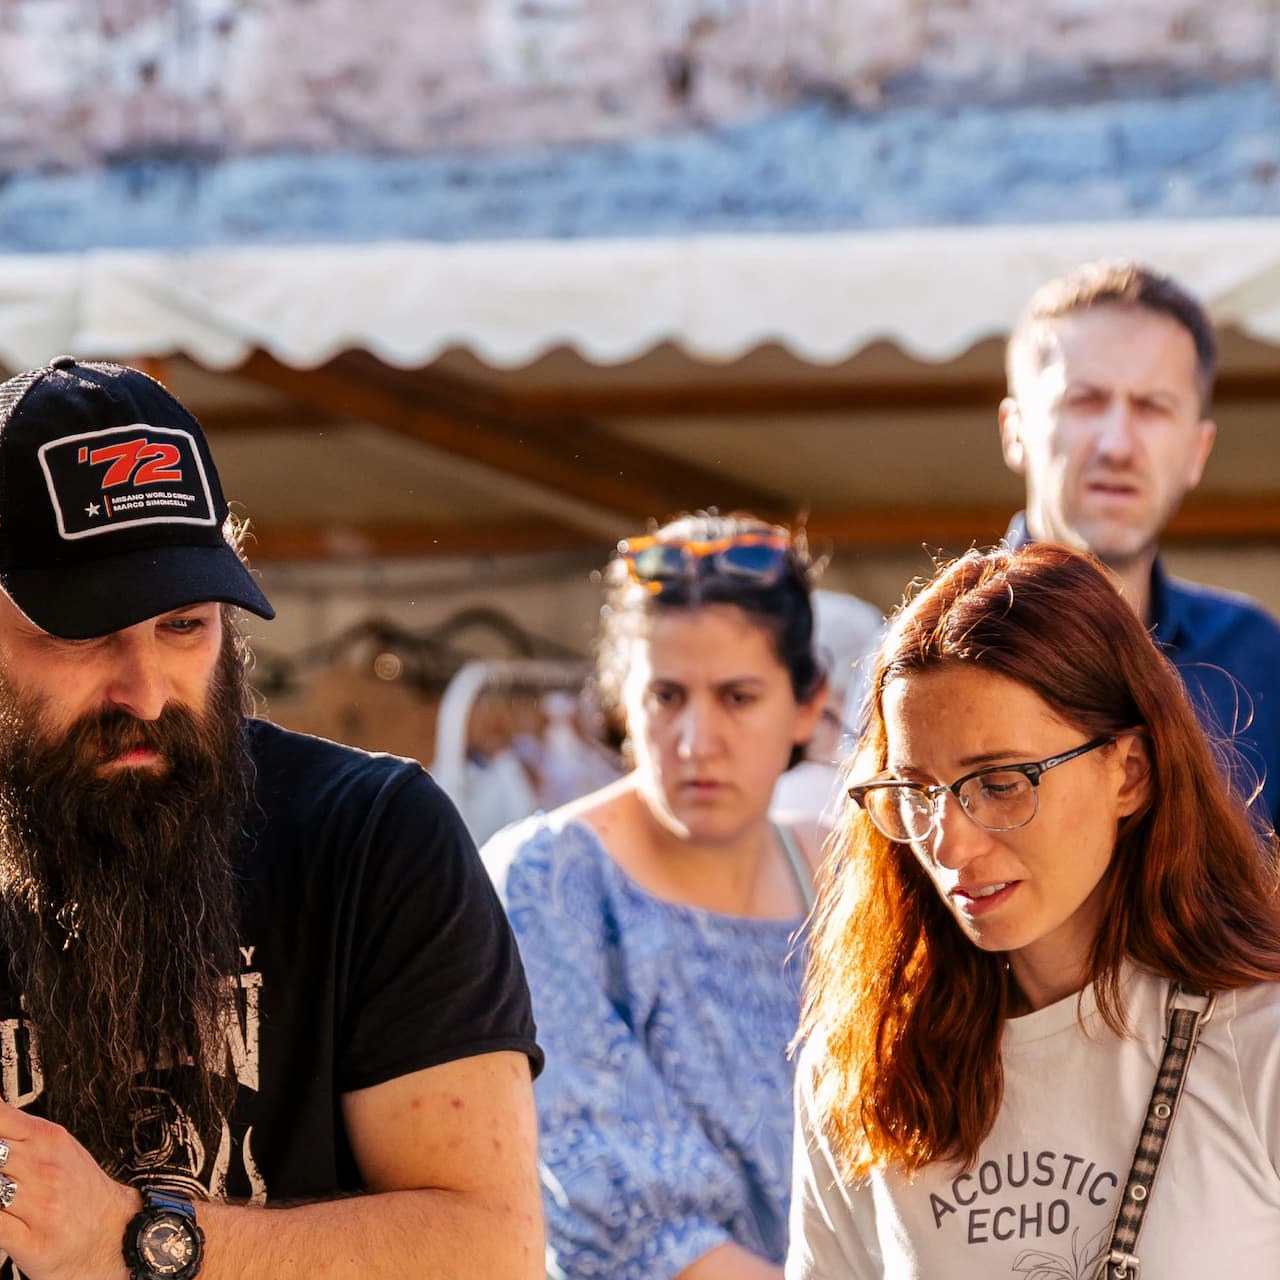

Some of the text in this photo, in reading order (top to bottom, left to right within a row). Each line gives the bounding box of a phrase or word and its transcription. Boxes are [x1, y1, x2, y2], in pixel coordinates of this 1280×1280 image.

[111, 493, 144, 504] MISANO
[145, 491, 173, 500] WORLD
[113, 502, 144, 511] MARCO
[929, 1151, 1118, 1229] ACOUSTIC
[968, 1199, 1070, 1244] ECHO
